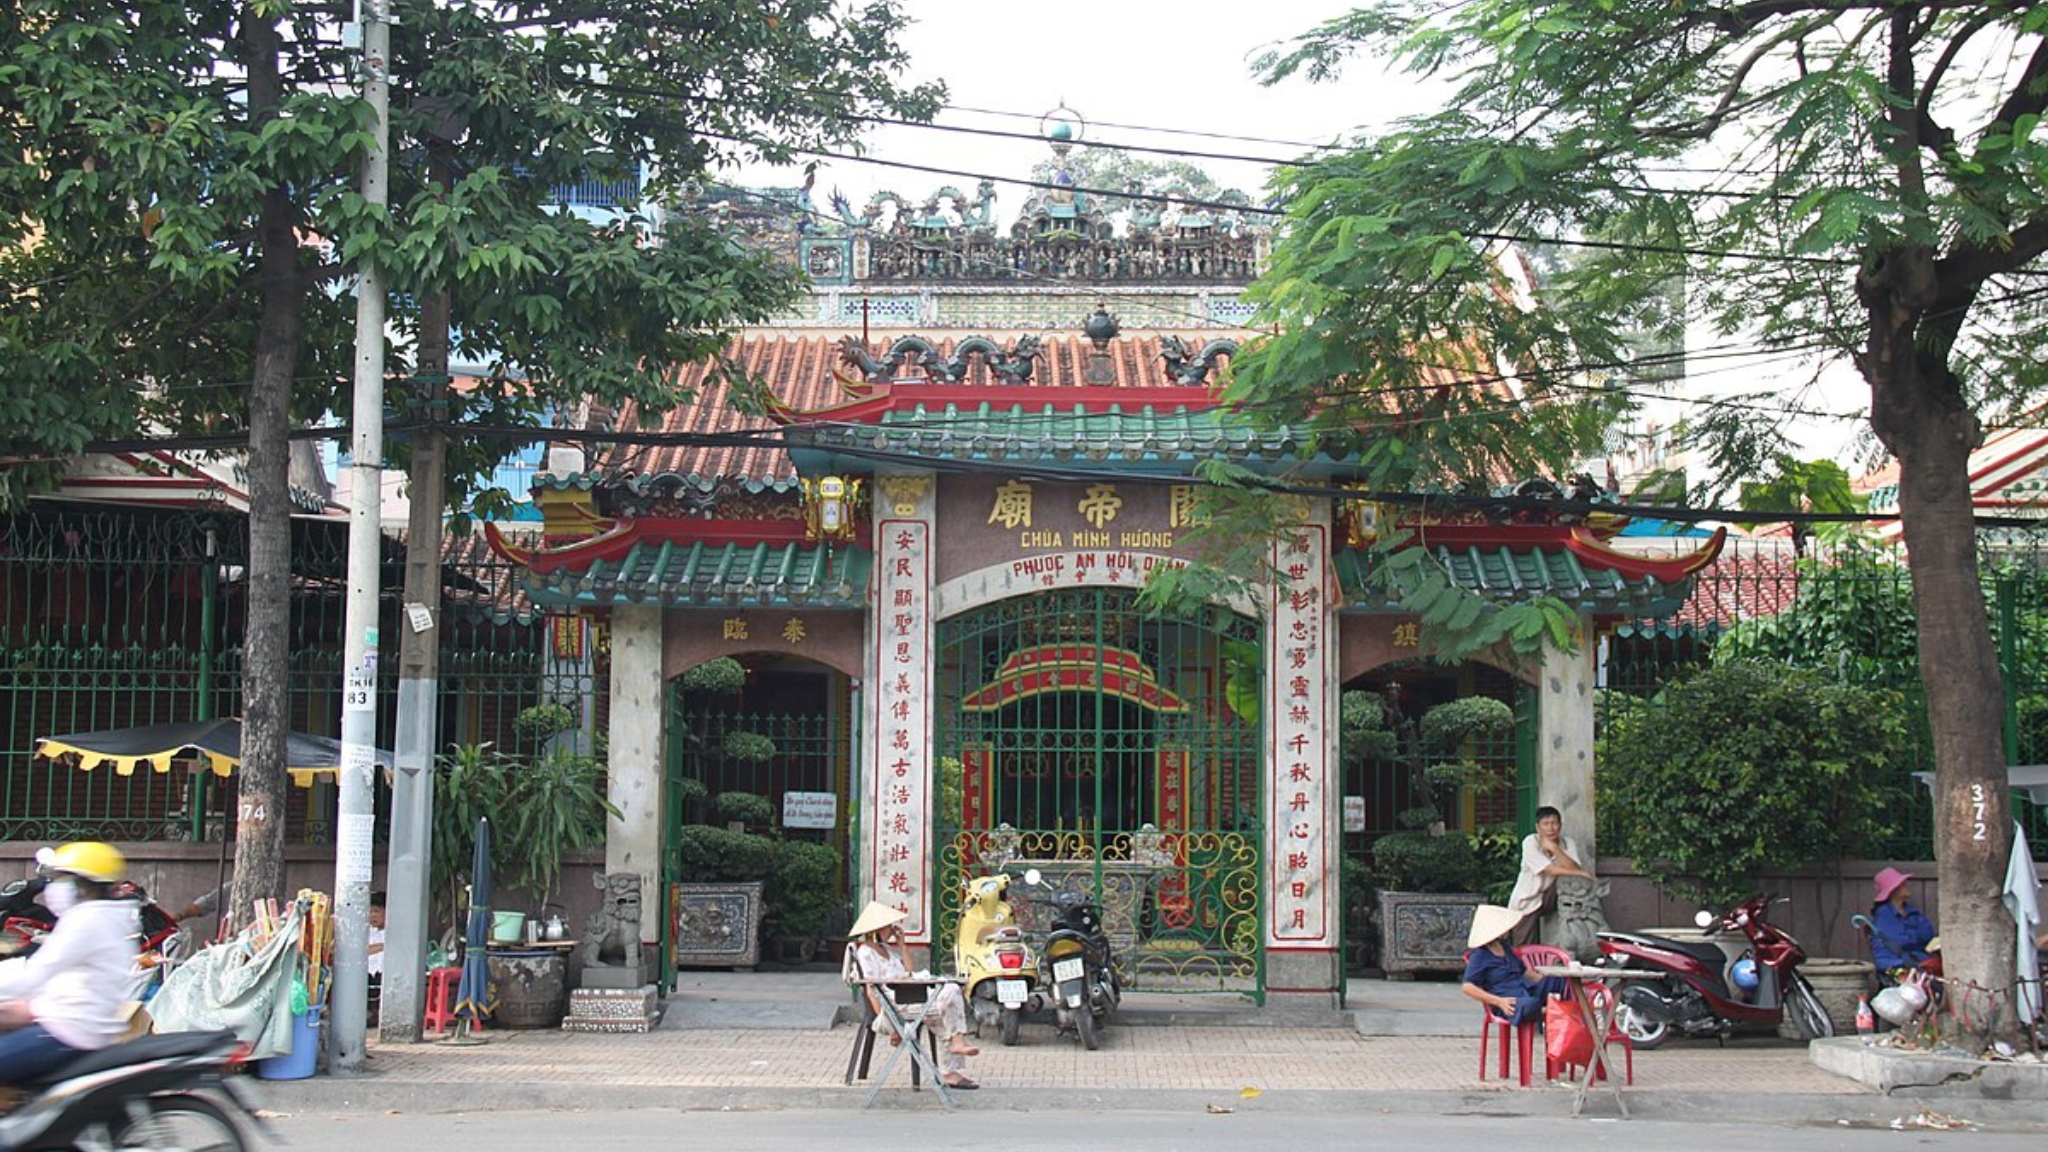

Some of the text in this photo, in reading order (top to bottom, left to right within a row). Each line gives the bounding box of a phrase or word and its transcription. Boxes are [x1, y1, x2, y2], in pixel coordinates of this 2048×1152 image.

[1076, 553, 1095, 568] AN
[347, 691, 367, 705] 83
[1971, 784, 1986, 840] 372
